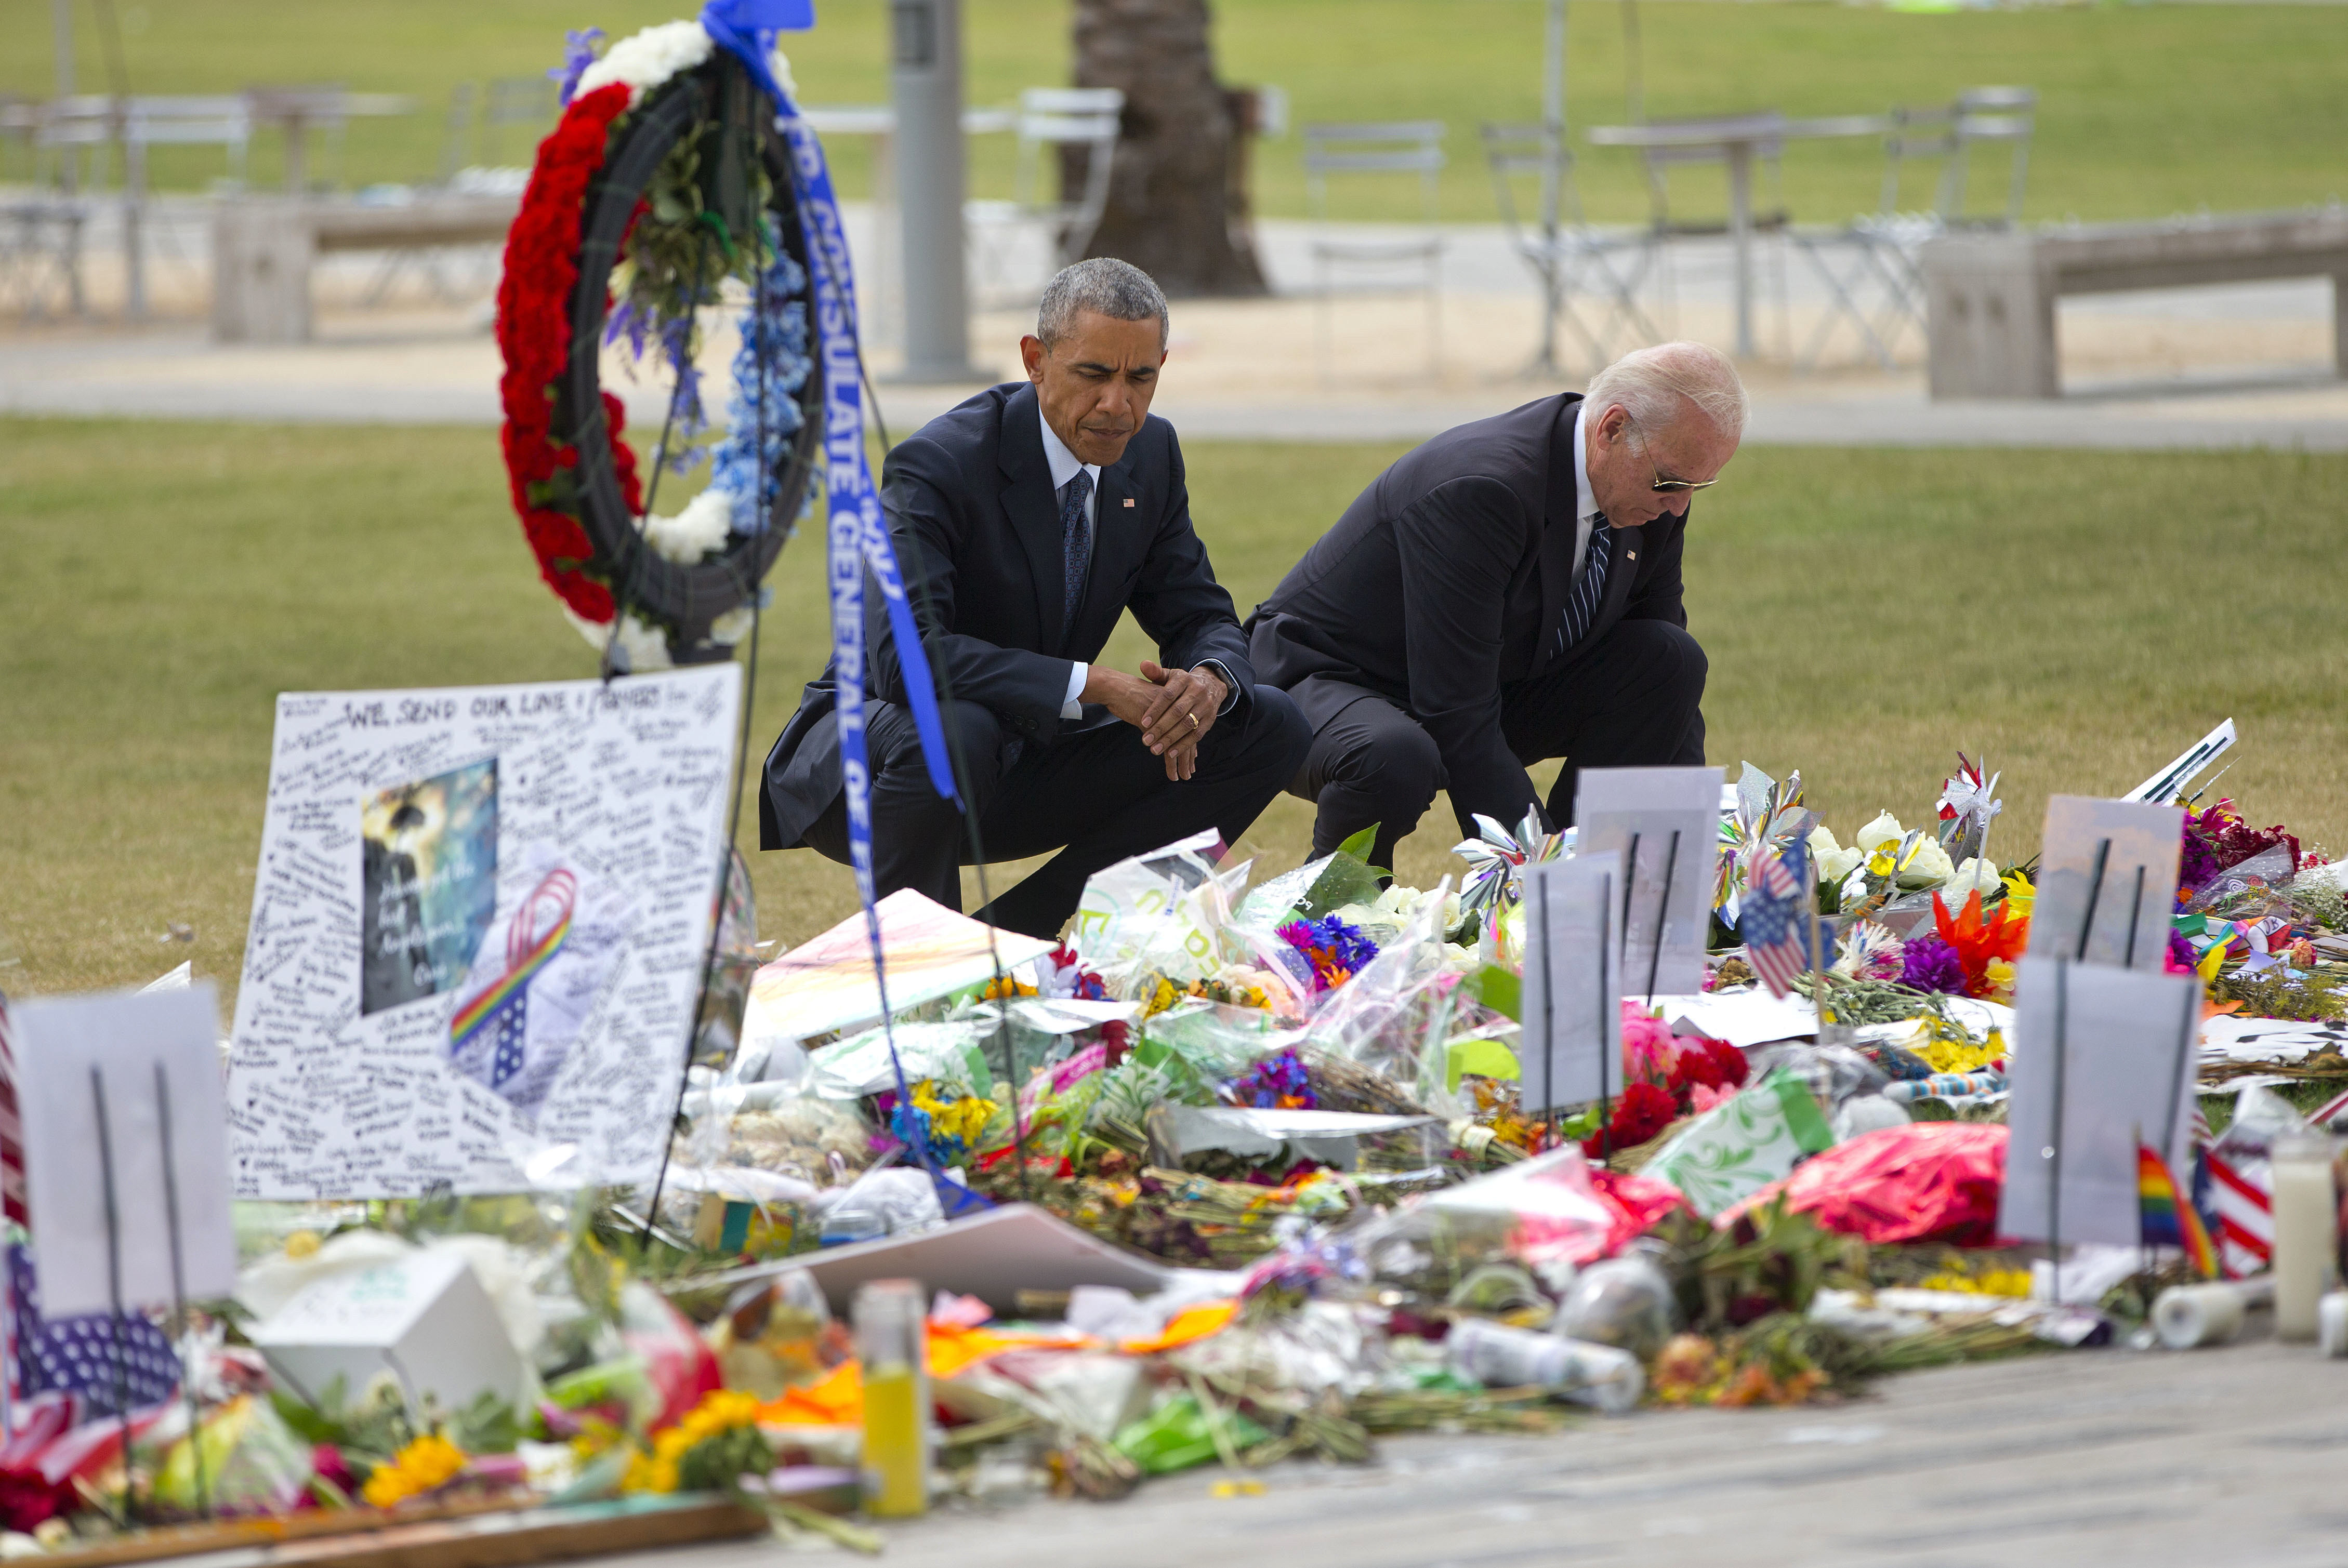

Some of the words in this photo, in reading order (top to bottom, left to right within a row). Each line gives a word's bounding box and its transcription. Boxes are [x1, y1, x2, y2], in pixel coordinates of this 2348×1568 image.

[798, 198, 864, 498] CONSULATE
[830, 509, 863, 743] GENERAL
[344, 700, 389, 728] WE
[395, 697, 457, 725] SEND
[469, 695, 511, 717] OUR
[520, 690, 565, 715] LOVE
[843, 757, 870, 831] OF
